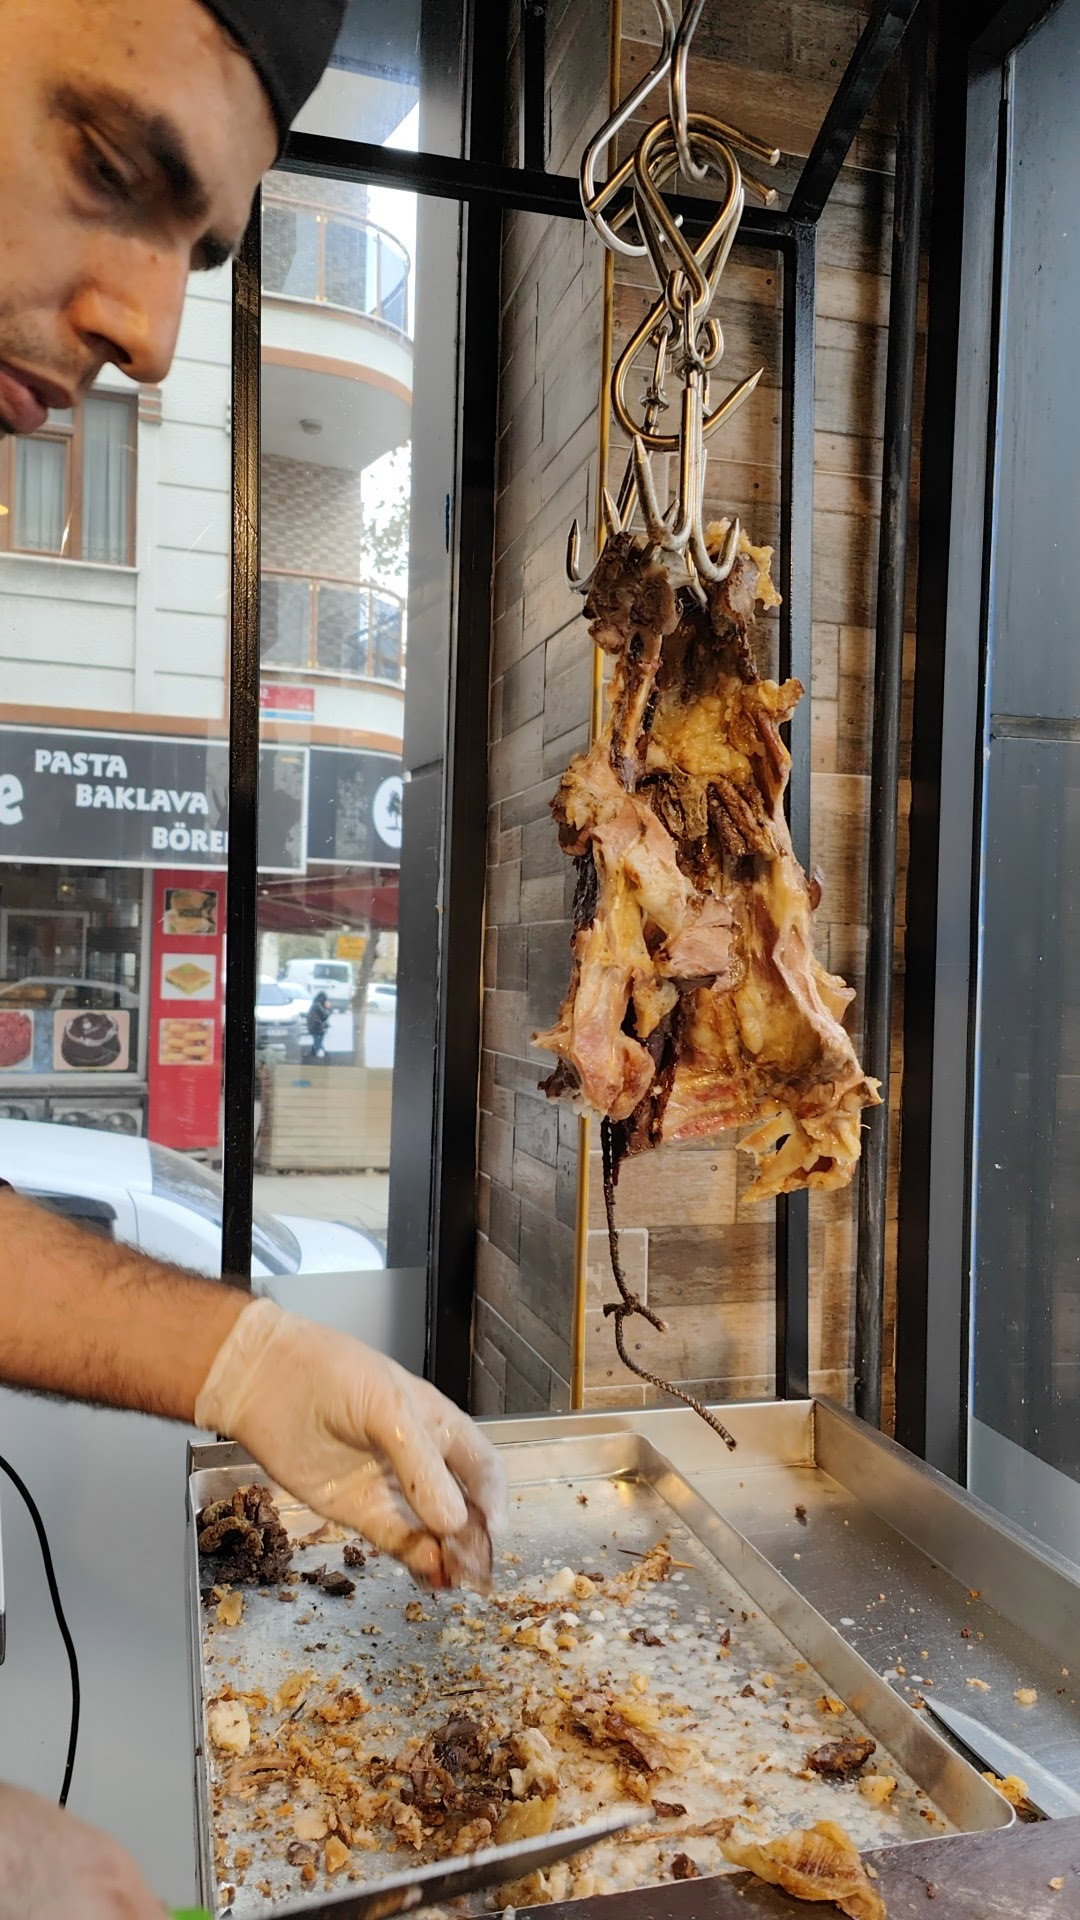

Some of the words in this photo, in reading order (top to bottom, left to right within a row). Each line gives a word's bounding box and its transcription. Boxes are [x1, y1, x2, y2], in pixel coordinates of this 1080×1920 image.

[35, 749, 128, 779] PASTA
[76, 783, 209, 815] BAKLAVA
[152, 822, 229, 854] BÖRE
